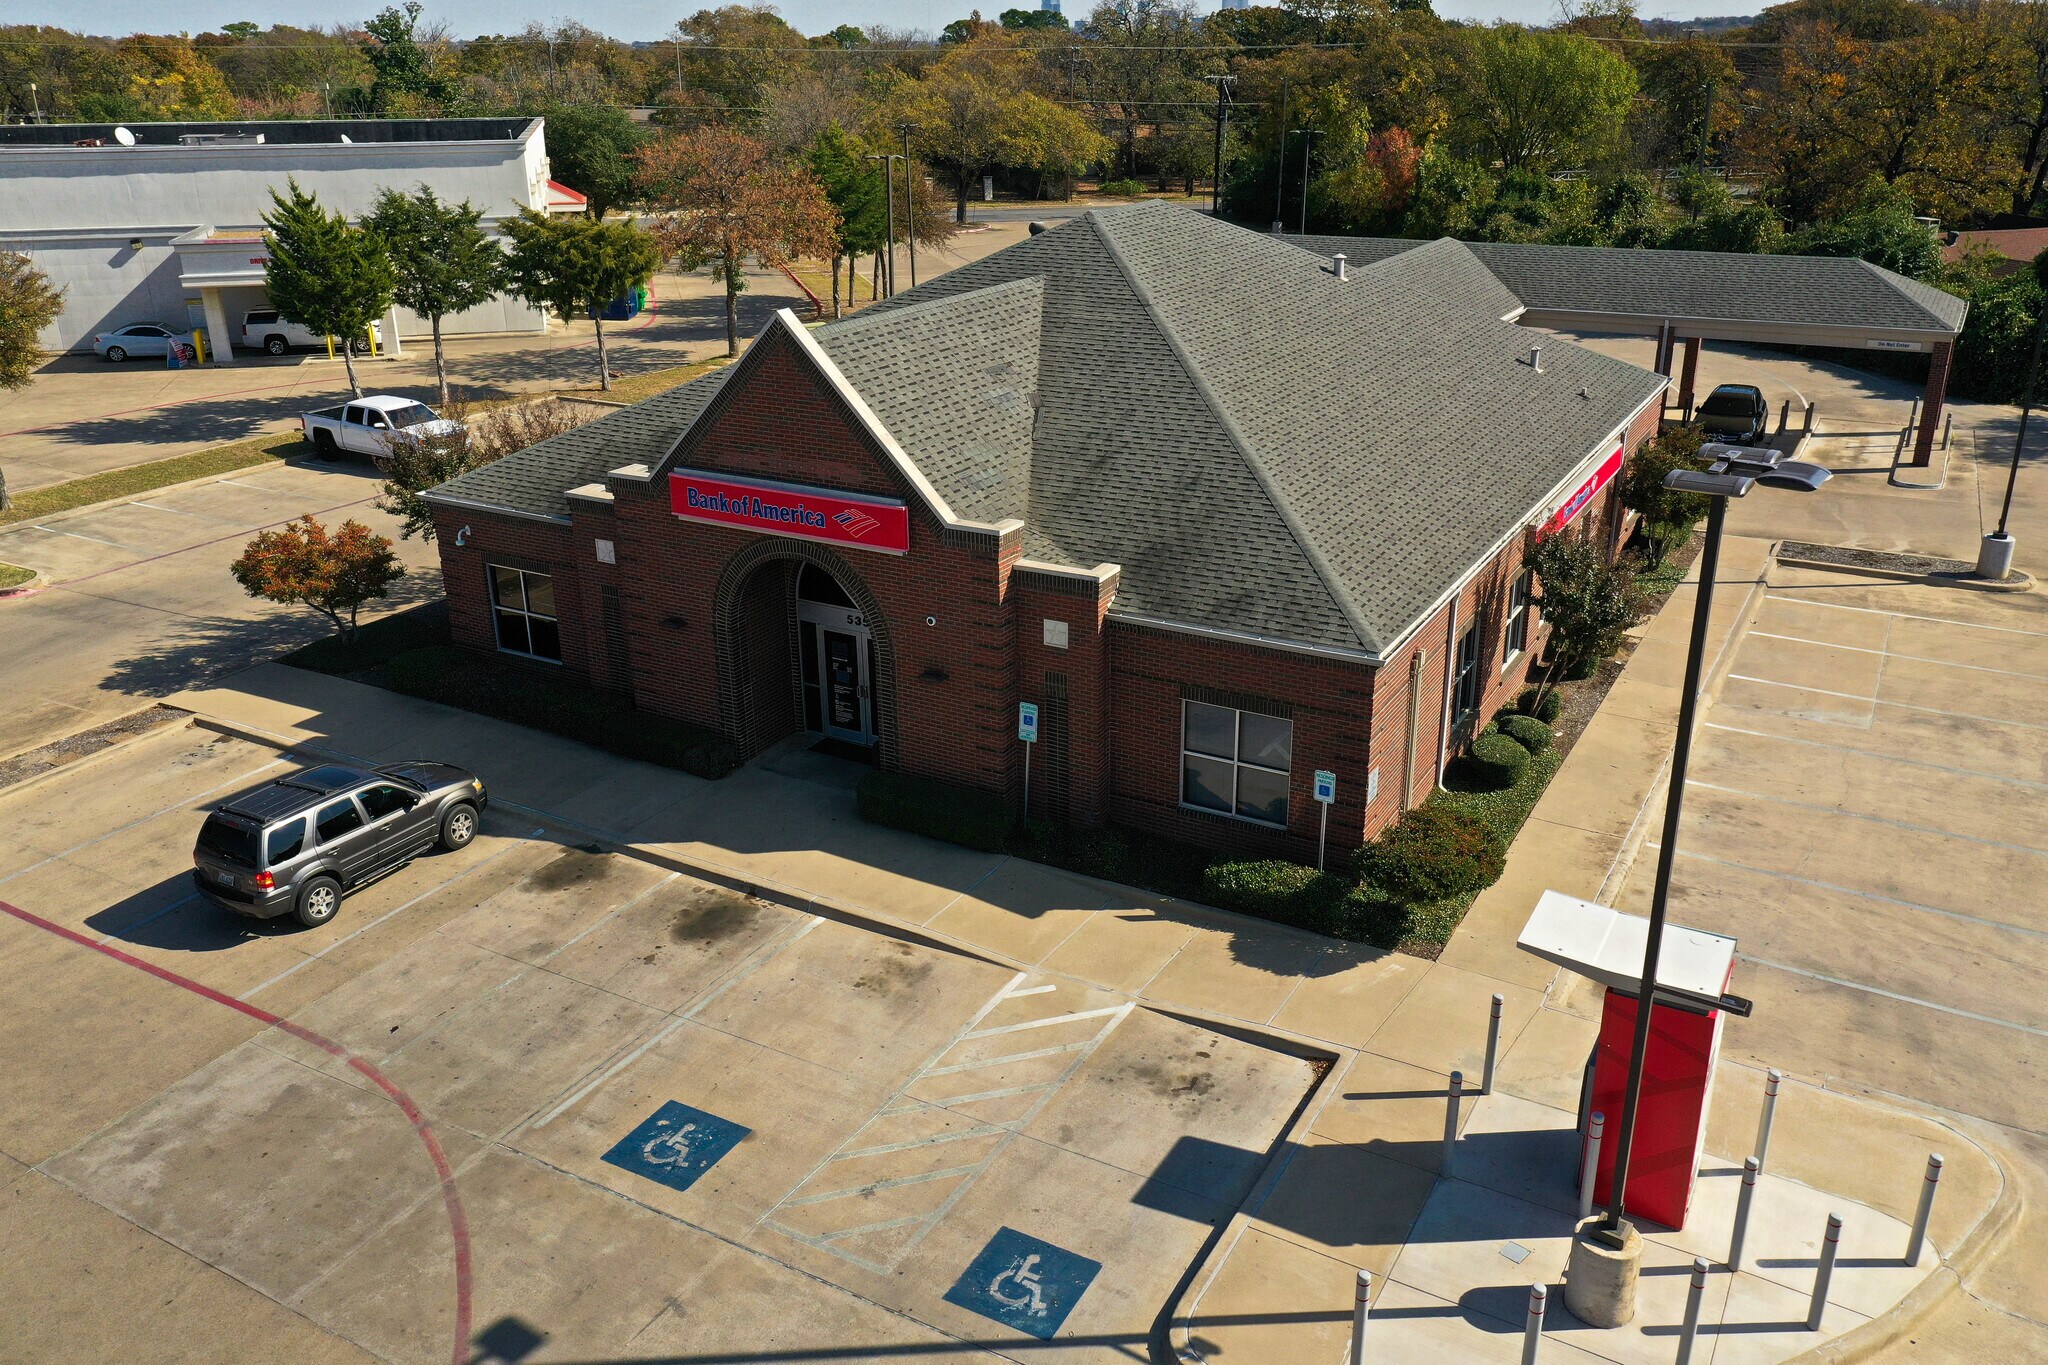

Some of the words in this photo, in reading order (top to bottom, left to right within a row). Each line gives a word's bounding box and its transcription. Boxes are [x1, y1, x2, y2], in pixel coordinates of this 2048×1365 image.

[687, 486, 730, 513] Bank
[731, 496, 749, 516] of
[751, 497, 826, 528] America
